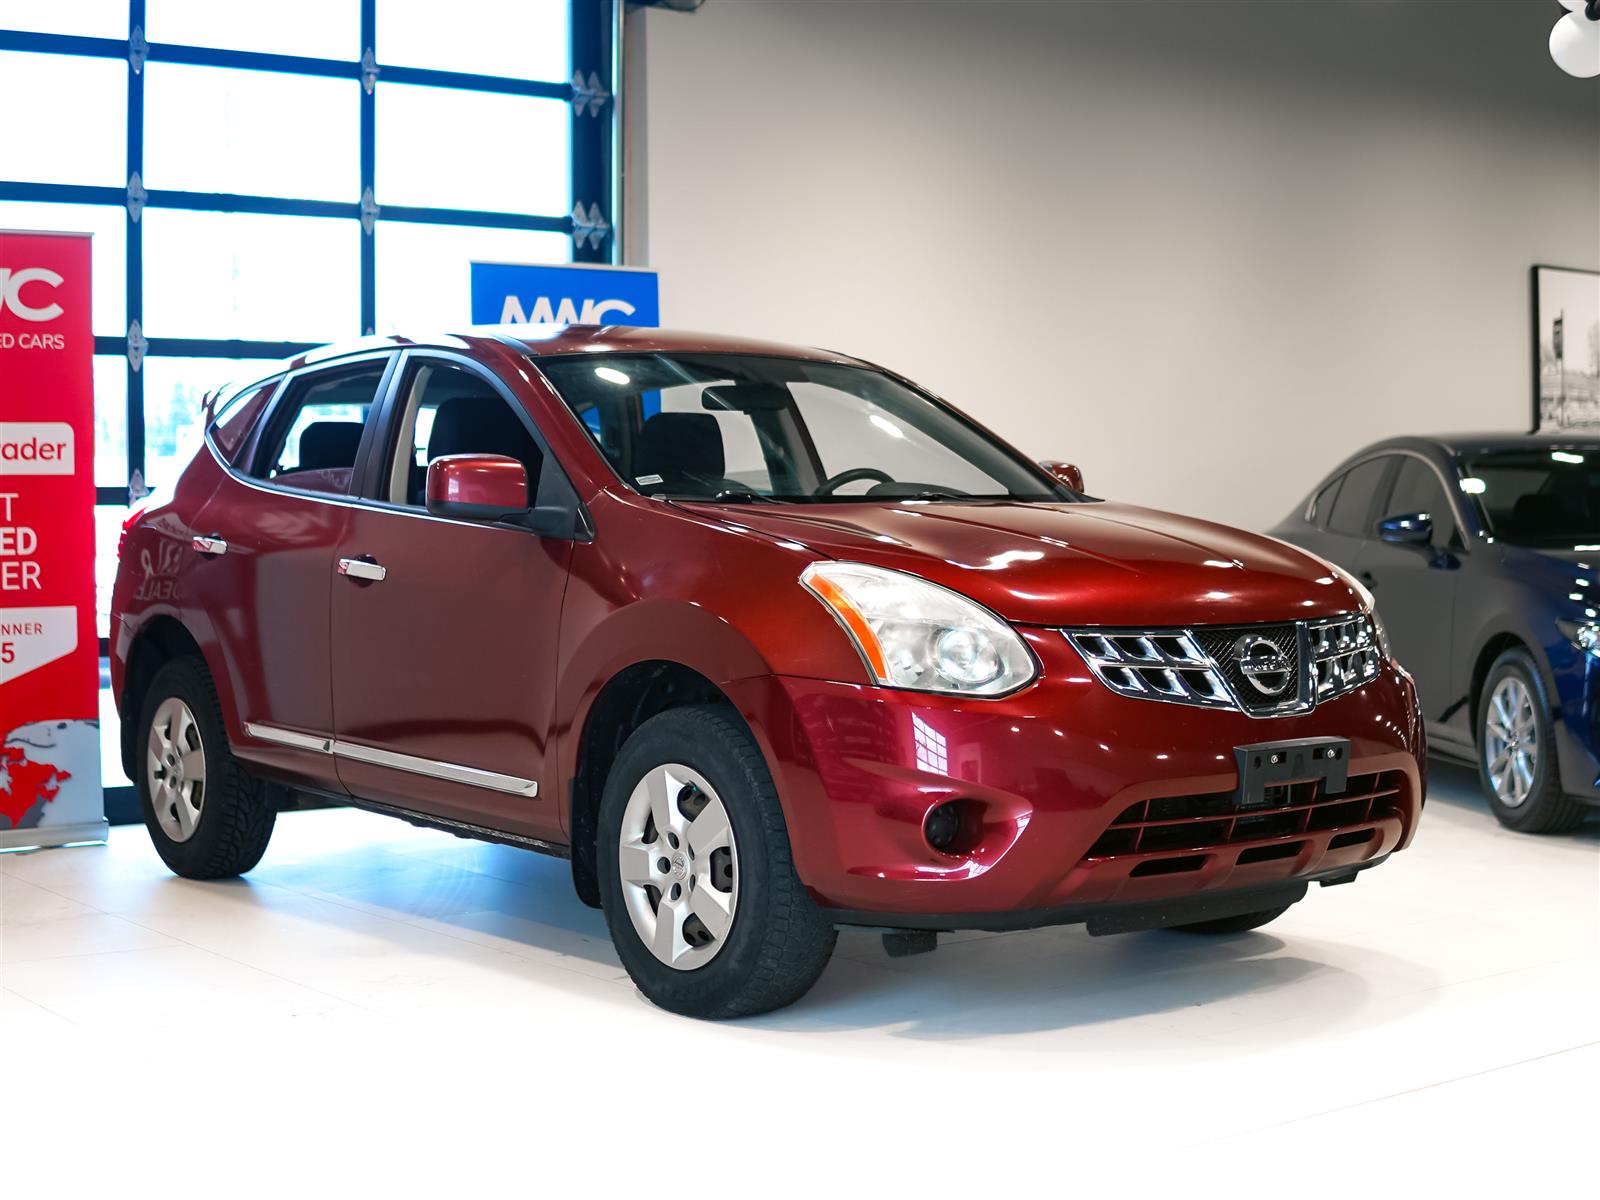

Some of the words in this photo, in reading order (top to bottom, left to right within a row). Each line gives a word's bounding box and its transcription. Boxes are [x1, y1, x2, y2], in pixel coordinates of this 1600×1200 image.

[0, 267, 64, 322] C
[0, 332, 15, 349] D
[18, 333, 65, 350] CARS
[0, 436, 67, 461] ader
[0, 526, 38, 556] ED
[1, 560, 42, 591] ER
[1, 622, 43, 636] NNER
[1, 641, 15, 664] 5
